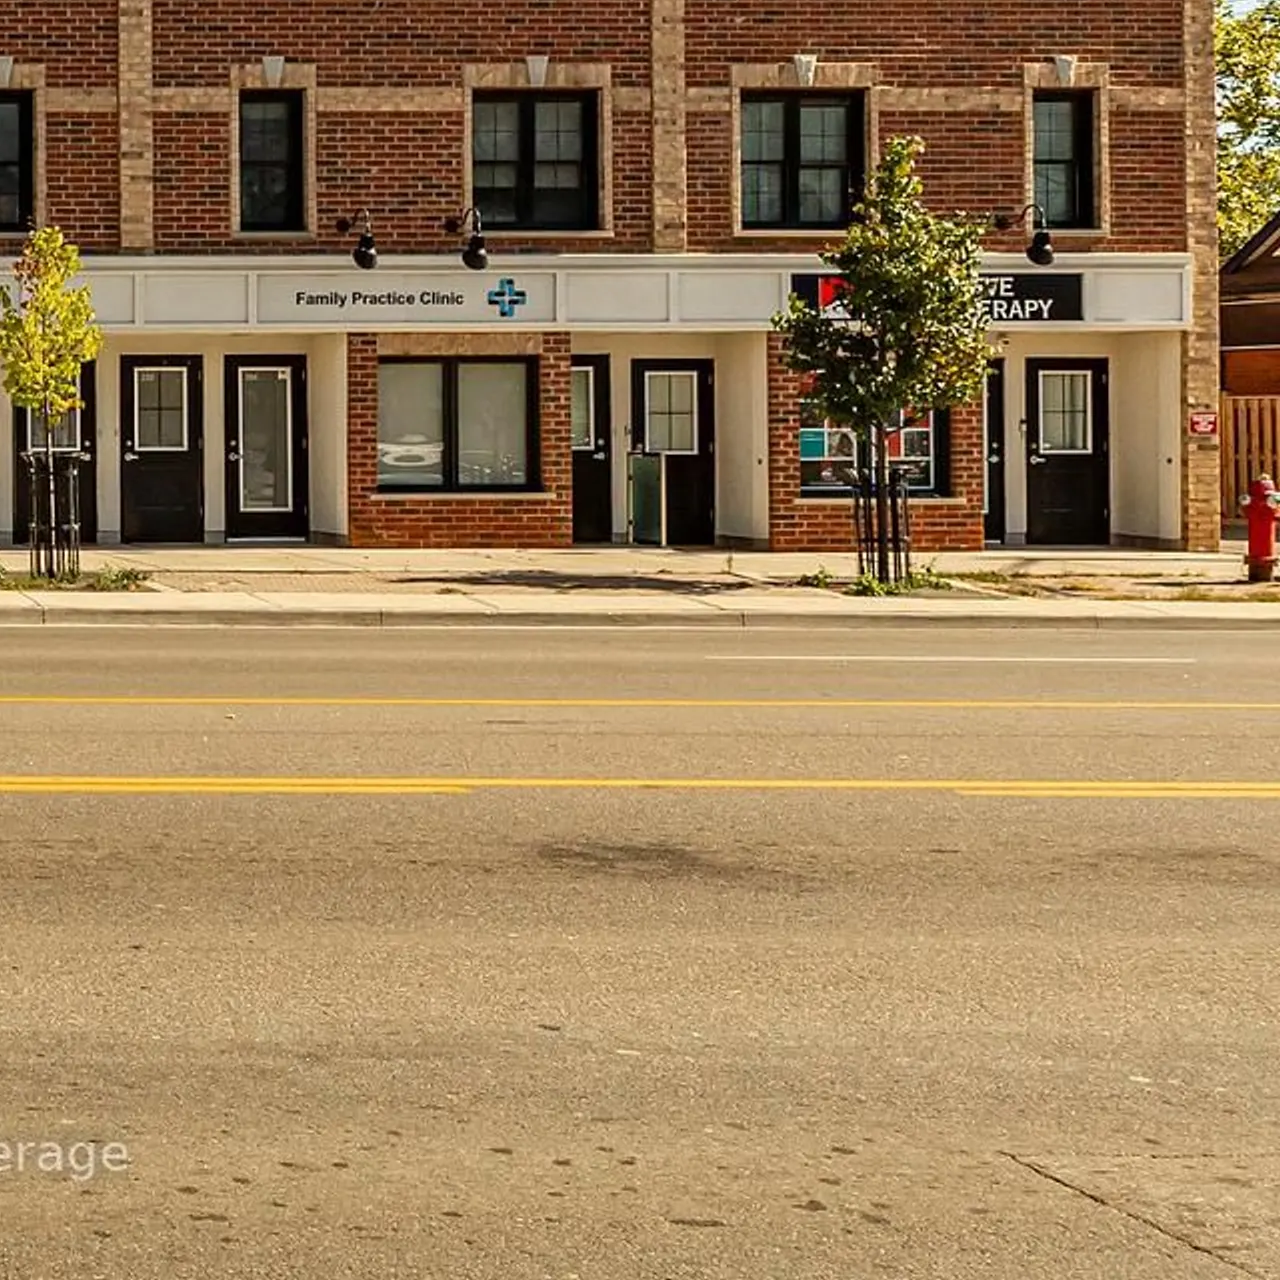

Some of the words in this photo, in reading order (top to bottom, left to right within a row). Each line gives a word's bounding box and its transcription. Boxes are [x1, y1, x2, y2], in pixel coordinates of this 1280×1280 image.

[295, 291, 347, 308] Family
[351, 291, 416, 306] Practice
[419, 291, 465, 306] Clinic
